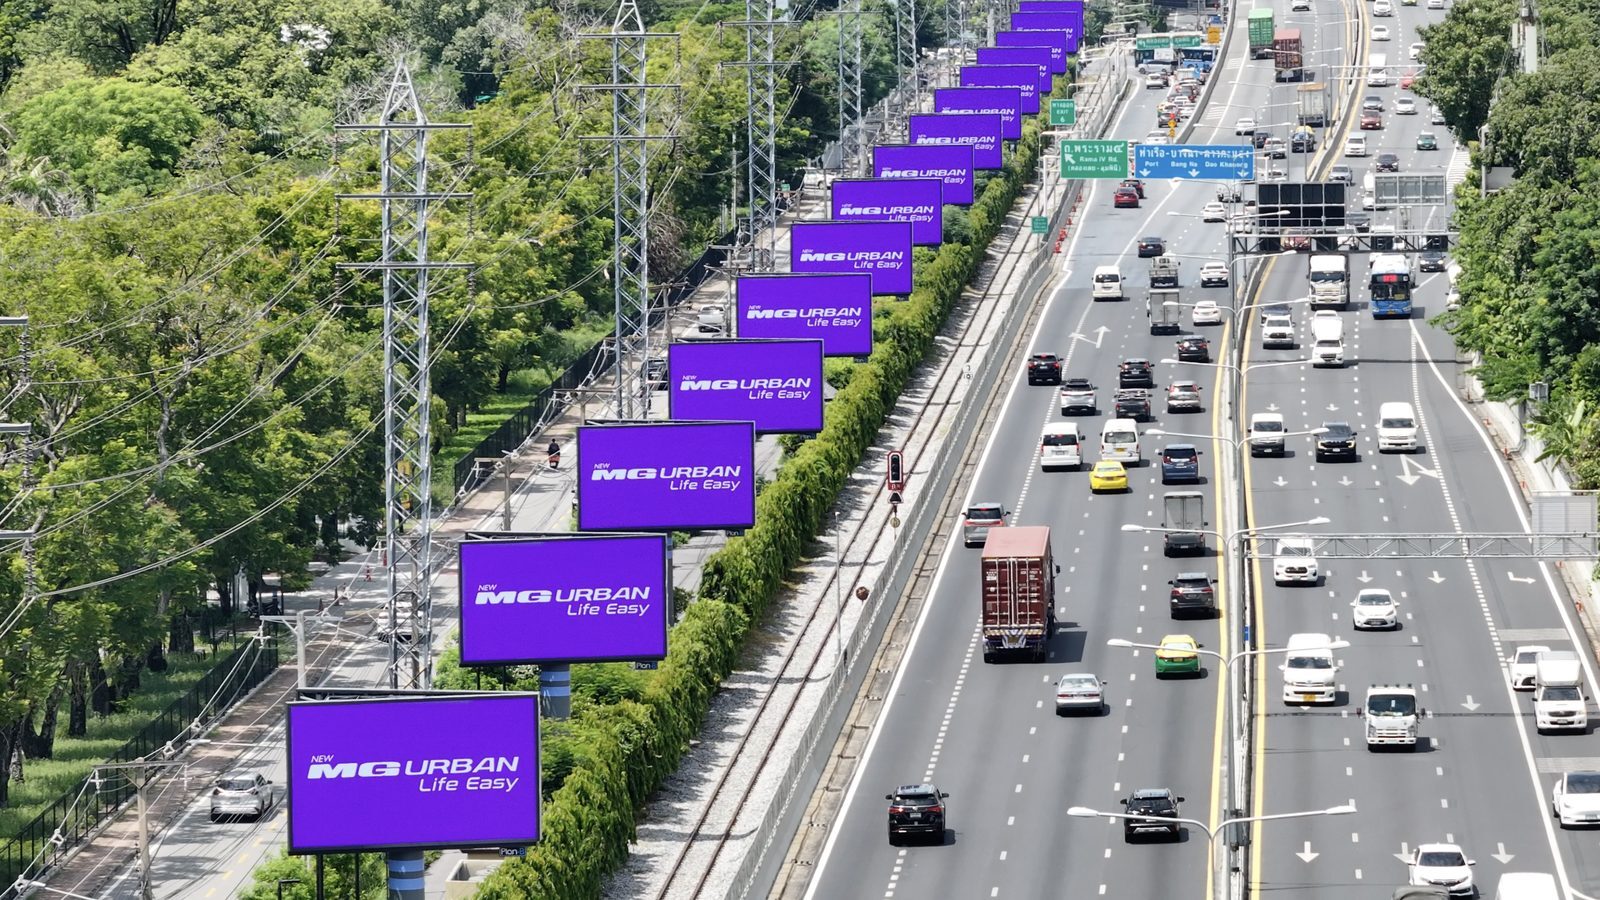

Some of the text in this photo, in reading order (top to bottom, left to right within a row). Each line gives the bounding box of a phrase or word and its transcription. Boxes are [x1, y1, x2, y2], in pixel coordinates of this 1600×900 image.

[916, 136, 995, 144] MG URBAN
[880, 169, 919, 178] MG
[920, 169, 967, 177] URBAN
[944, 176, 966, 184] Easy
[840, 206, 934, 215] MG URBAN
[910, 214, 934, 222] Easy
[800, 251, 904, 262] MG URBAN
[854, 261, 903, 270] Life Easy
[746, 307, 861, 319] MG URBAN
[807, 318, 862, 328] Life Easy
[680, 378, 812, 391] MG URBAN
[749, 390, 811, 401] Life Easy
[591, 466, 741, 480] MG URBAN
[670, 479, 741, 492] Life Easy
[478, 584, 498, 592] NEW
[475, 587, 650, 605] MG URBAN
[567, 603, 650, 616] Life Easy
[311, 755, 335, 763] NEW
[307, 756, 520, 780] MG URBAN
[419, 776, 520, 793] Life Easy
